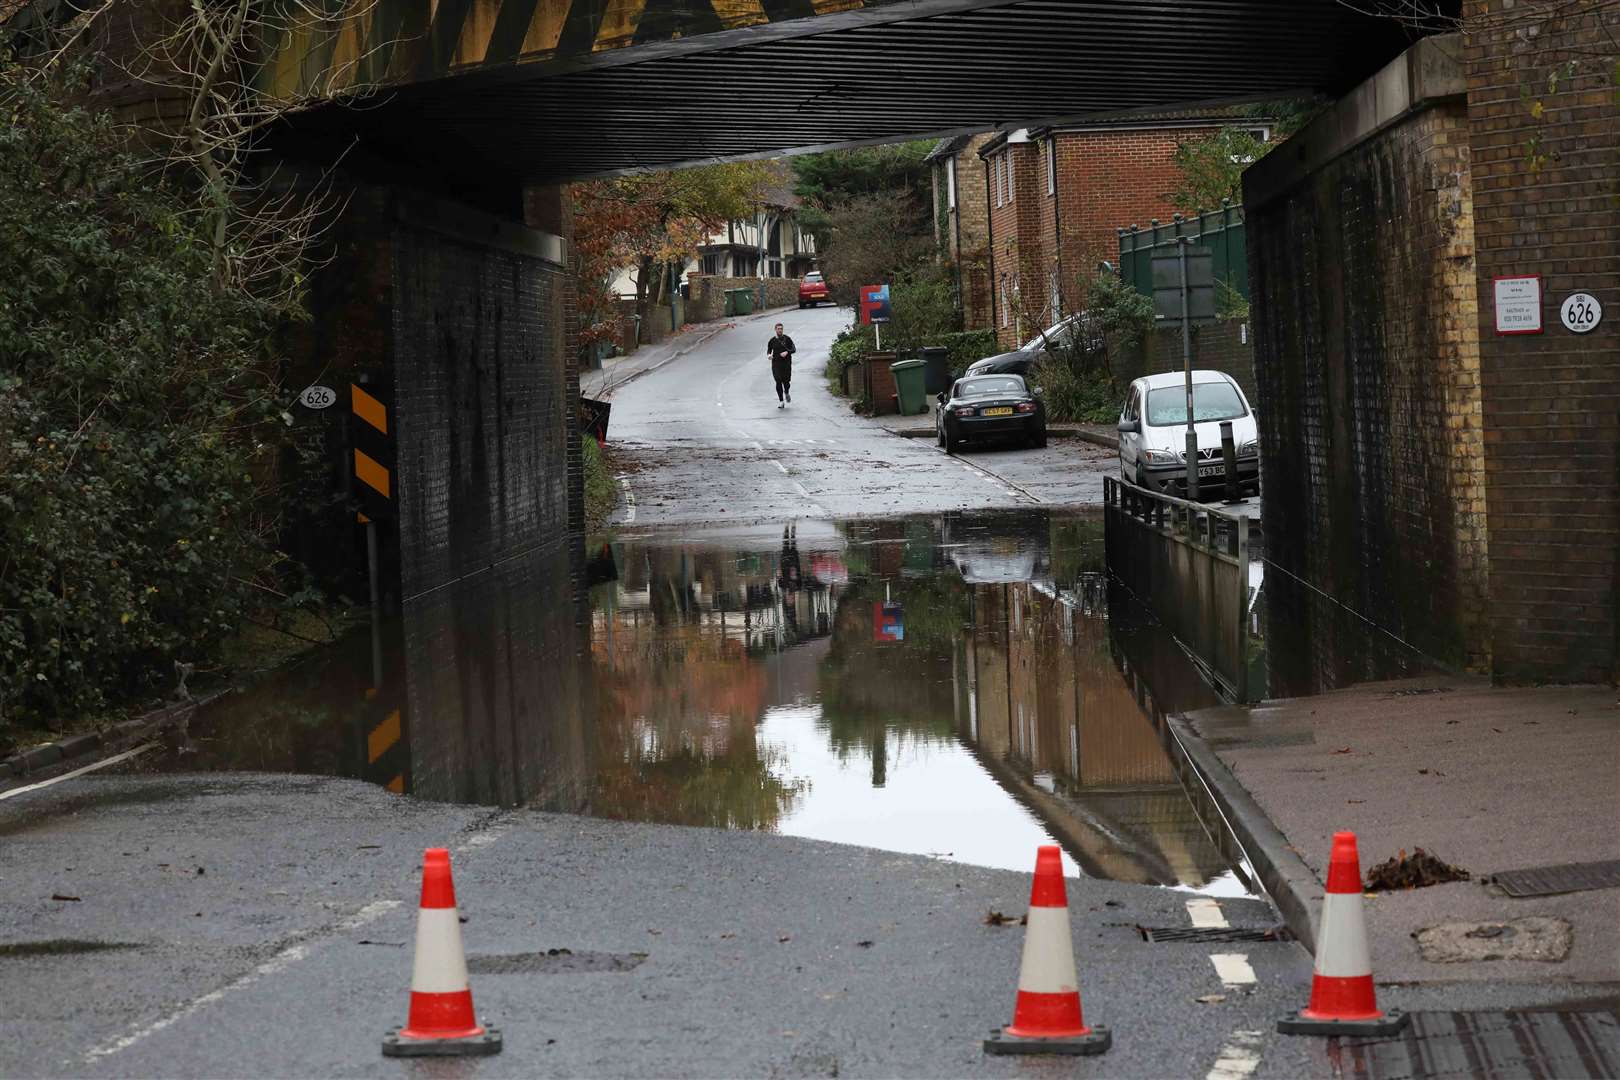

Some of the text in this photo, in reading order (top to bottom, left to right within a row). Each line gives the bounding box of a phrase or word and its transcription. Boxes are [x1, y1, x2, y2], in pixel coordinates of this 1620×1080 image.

[1568, 303, 1594, 324] 626
[307, 391, 329, 404] 626
[1199, 466, 1225, 476] Y53 BC
